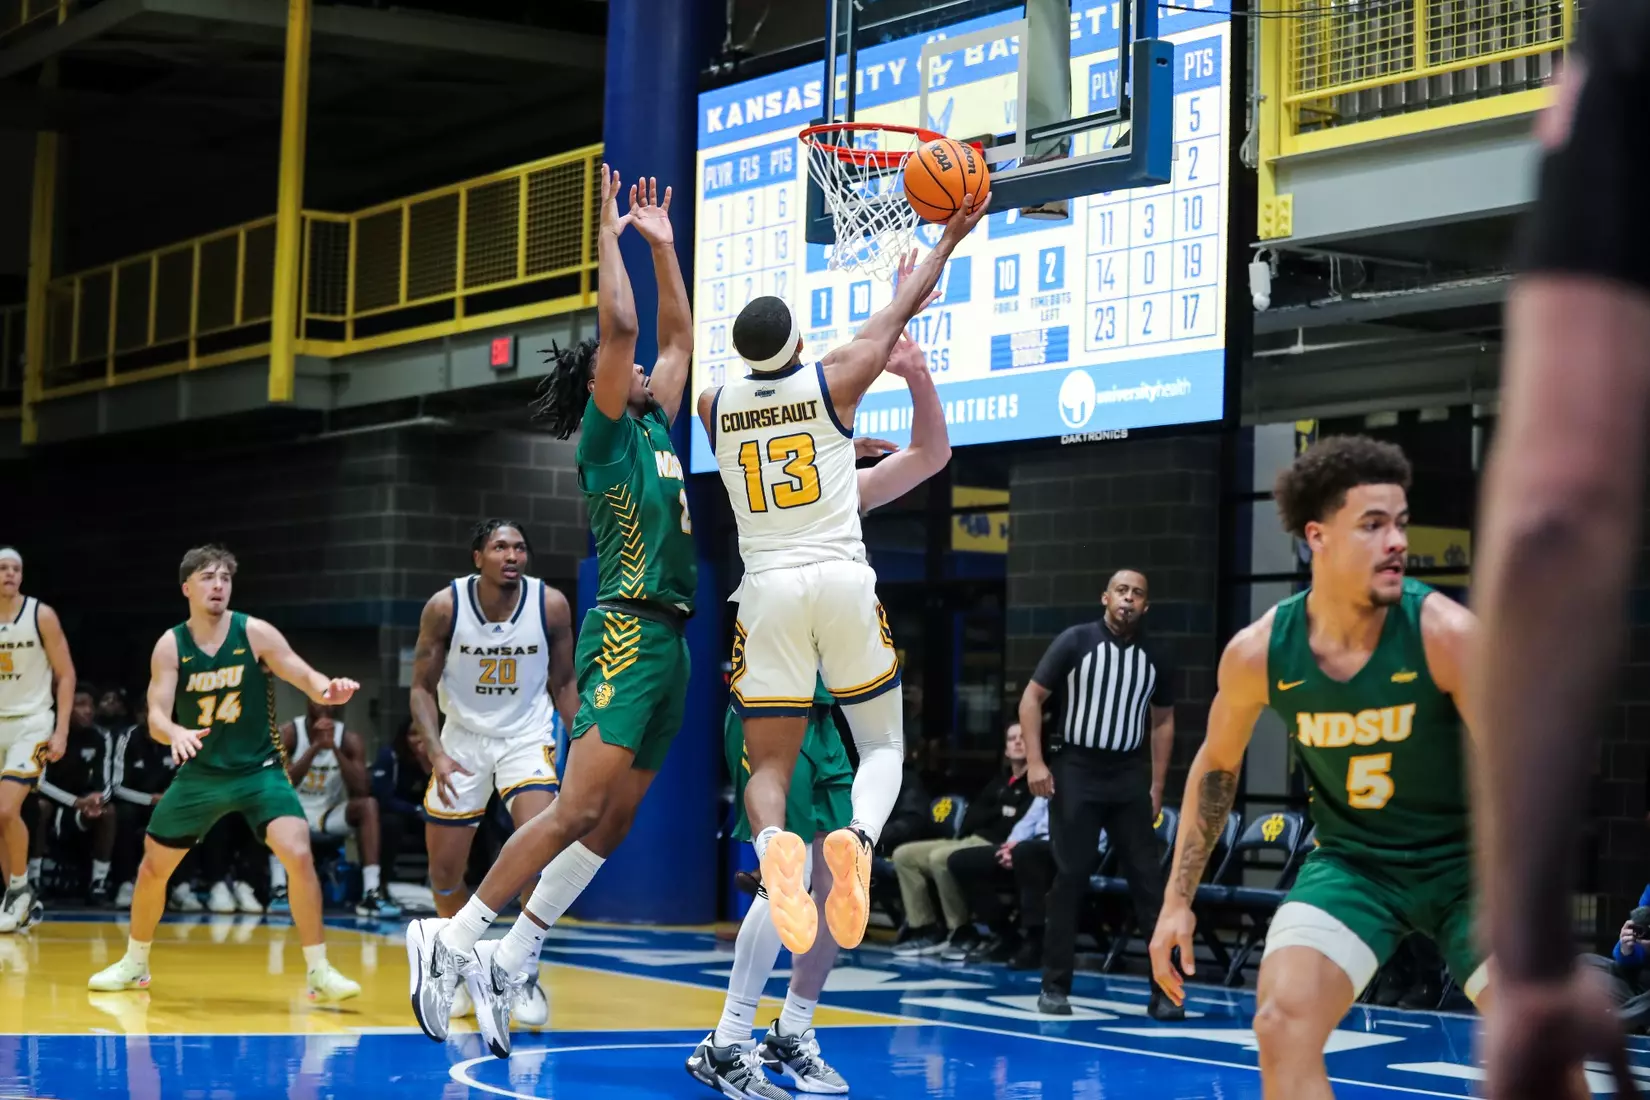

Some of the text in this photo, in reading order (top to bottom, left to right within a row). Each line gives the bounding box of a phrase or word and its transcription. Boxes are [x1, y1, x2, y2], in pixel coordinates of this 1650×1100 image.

[1184, 47, 1214, 81] PTS
[706, 80, 822, 134] KANSAS
[834, 57, 908, 101] CITY
[1092, 70, 1119, 101] PLY
[1189, 97, 1201, 132] 5
[739, 155, 760, 183] FLS
[770, 147, 792, 176] PTS
[1187, 146, 1198, 181] 2
[747, 195, 755, 225] 3
[778, 188, 787, 219] 6
[1100, 195, 1202, 246] 11 3 10
[716, 242, 724, 272] 5
[745, 236, 754, 266] 3
[774, 229, 788, 260] 13
[997, 259, 1016, 292] 10
[1045, 252, 1056, 284] 2
[1096, 243, 1202, 293] 14 0 19
[712, 282, 726, 311] 13
[774, 270, 787, 299] 12
[820, 291, 828, 320] 1
[853, 284, 869, 314] 10
[1095, 294, 1200, 342] 23 2 17
[709, 324, 726, 355] 20
[721, 400, 819, 434] COURSEAULT
[943, 393, 1019, 425] ARTNERS
[1060, 429, 1129, 445] DAKTRONICS
[738, 432, 822, 513] 13
[459, 644, 539, 656] KANSAS
[186, 665, 245, 693] NDSU
[478, 658, 517, 685] 20
[475, 686, 521, 696] CITY
[196, 691, 243, 727] 14
[1296, 703, 1417, 749] NDSU
[1346, 752, 1396, 810] 5
